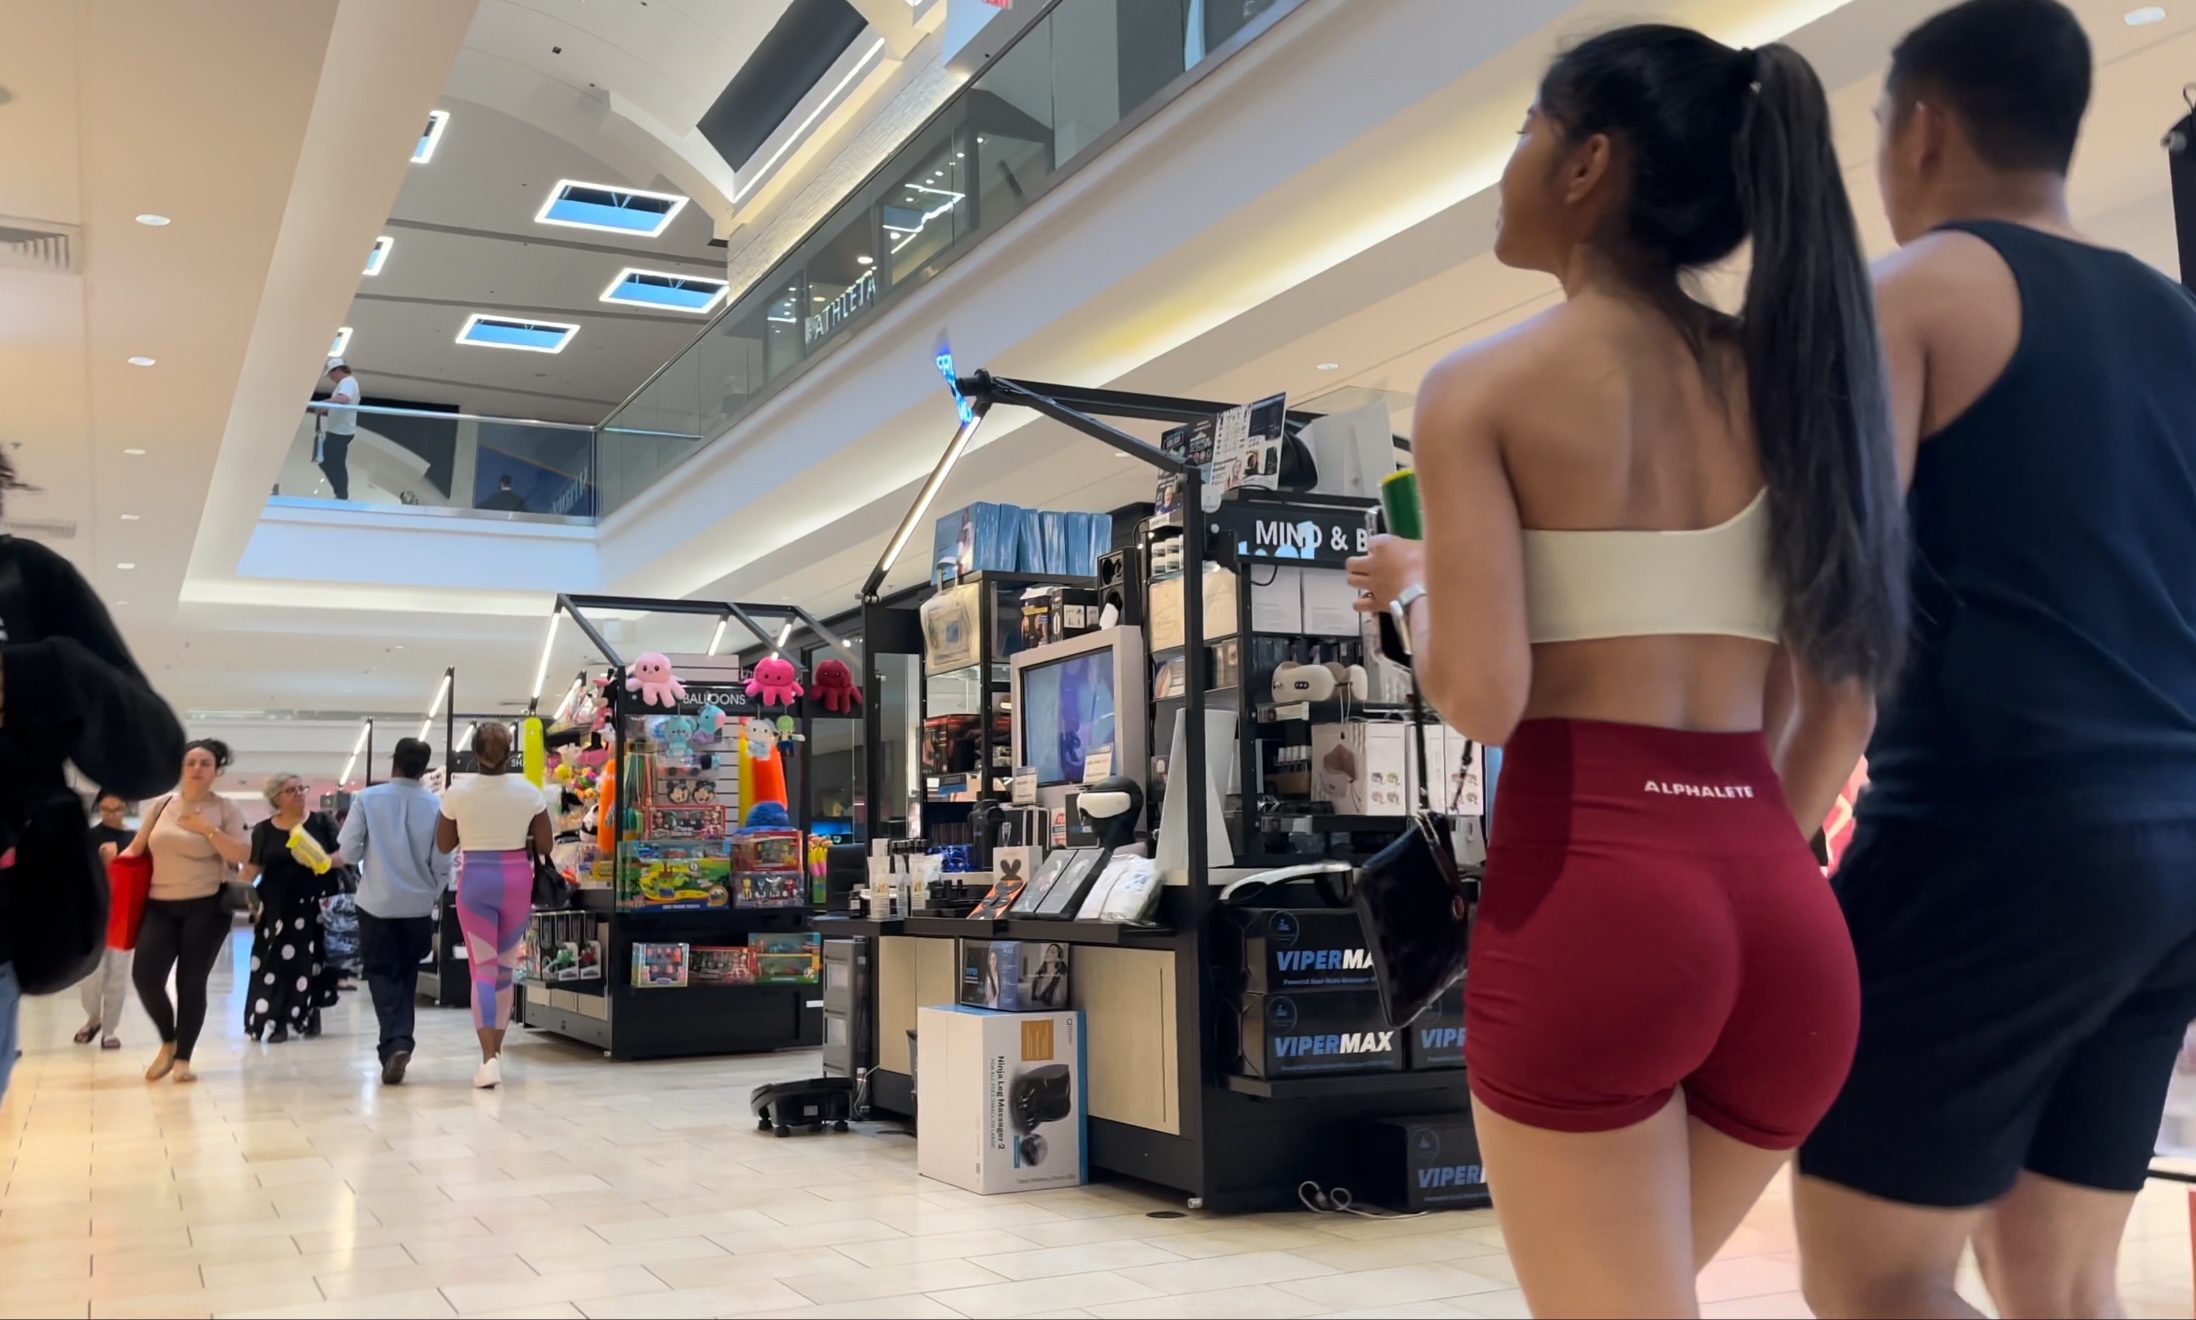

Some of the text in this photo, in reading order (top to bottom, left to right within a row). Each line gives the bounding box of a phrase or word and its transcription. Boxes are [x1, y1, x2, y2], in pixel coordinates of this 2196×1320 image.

[813, 270, 876, 340] ATHLETA
[1255, 519, 1323, 550] MIND
[1330, 525, 1349, 552] &
[683, 692, 746, 705] BALLOONS
[1643, 780, 1755, 799] ALPHALETE
[1274, 1030, 1395, 1058] VIPERMAX
[996, 1055, 1005, 1079] Ninja
[996, 1080, 1005, 1097] Leg
[996, 1098, 1005, 1142] Massager
[1418, 1164, 1486, 1189] VIPER
